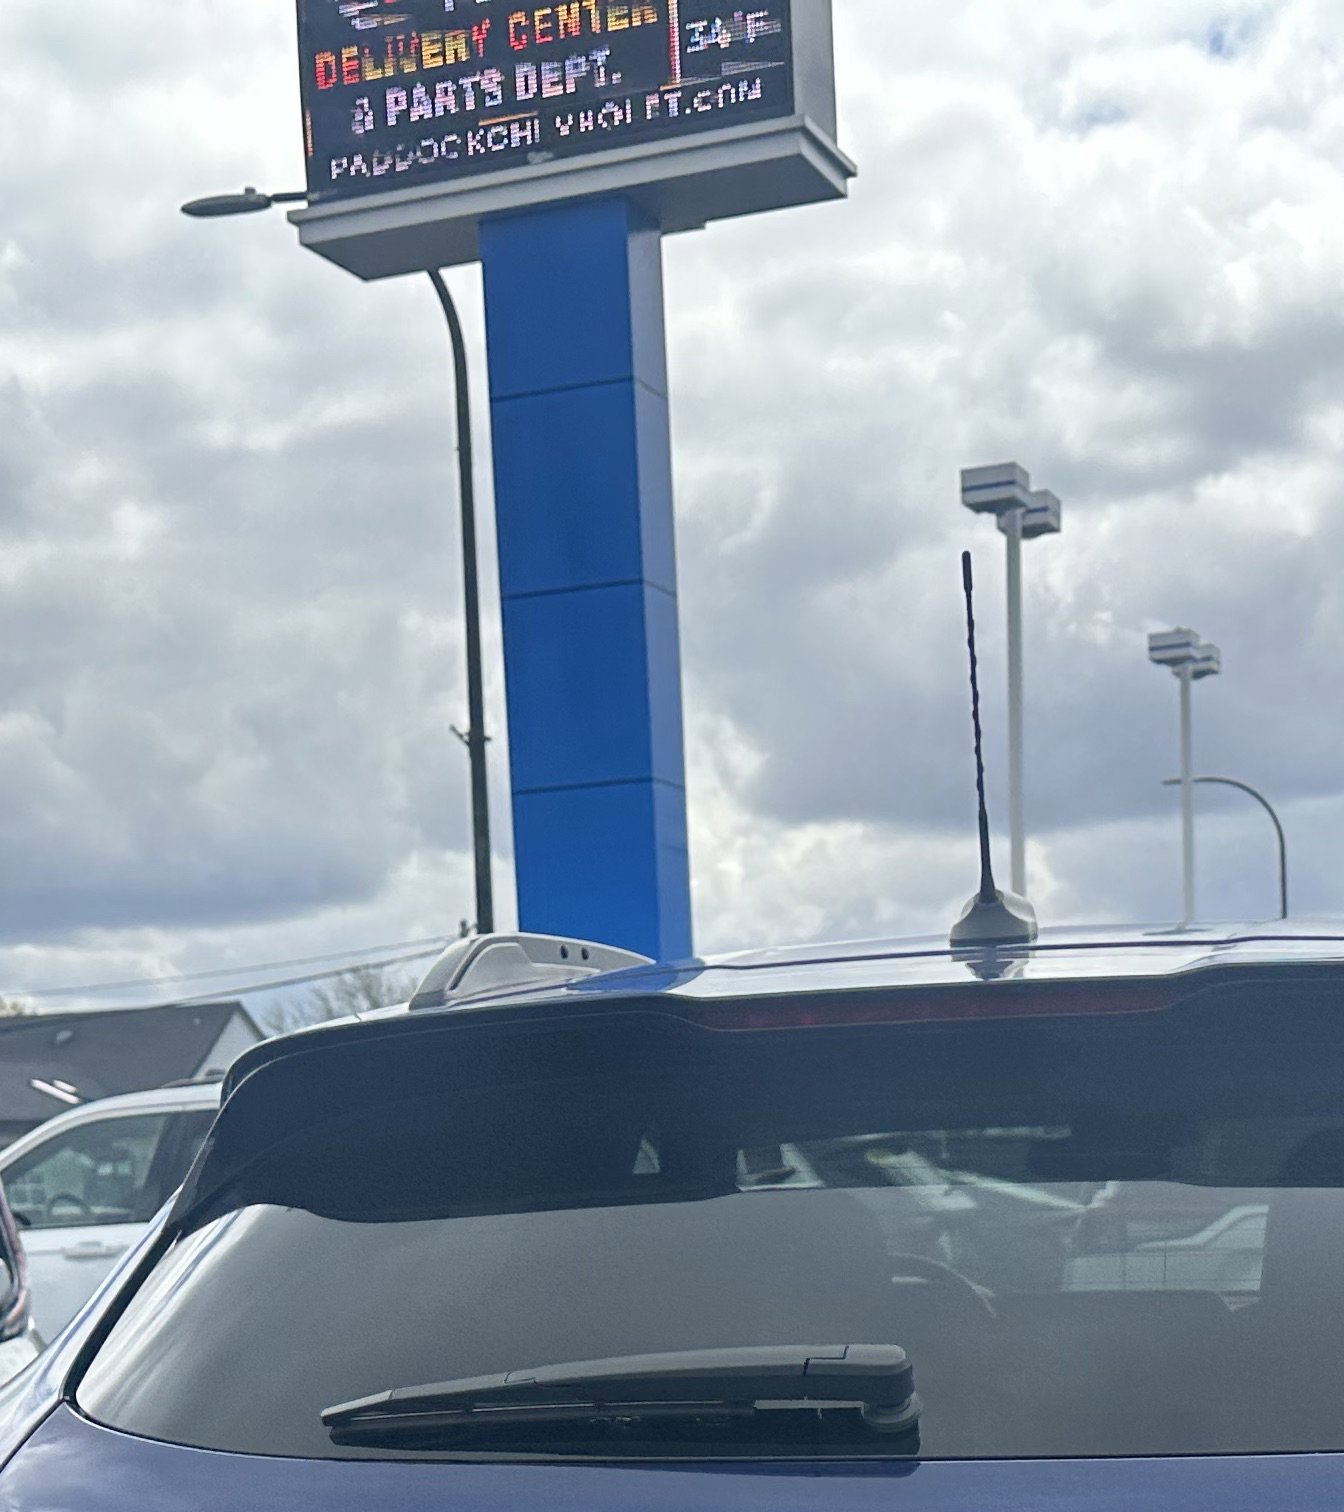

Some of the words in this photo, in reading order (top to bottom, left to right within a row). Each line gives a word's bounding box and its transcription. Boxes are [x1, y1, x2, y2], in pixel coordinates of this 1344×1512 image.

[314, 18, 490, 89] DELIVERY
[509, 0, 657, 50] CENTER
[386, 68, 504, 126] PARTS
[515, 46, 622, 100] DEPT.
